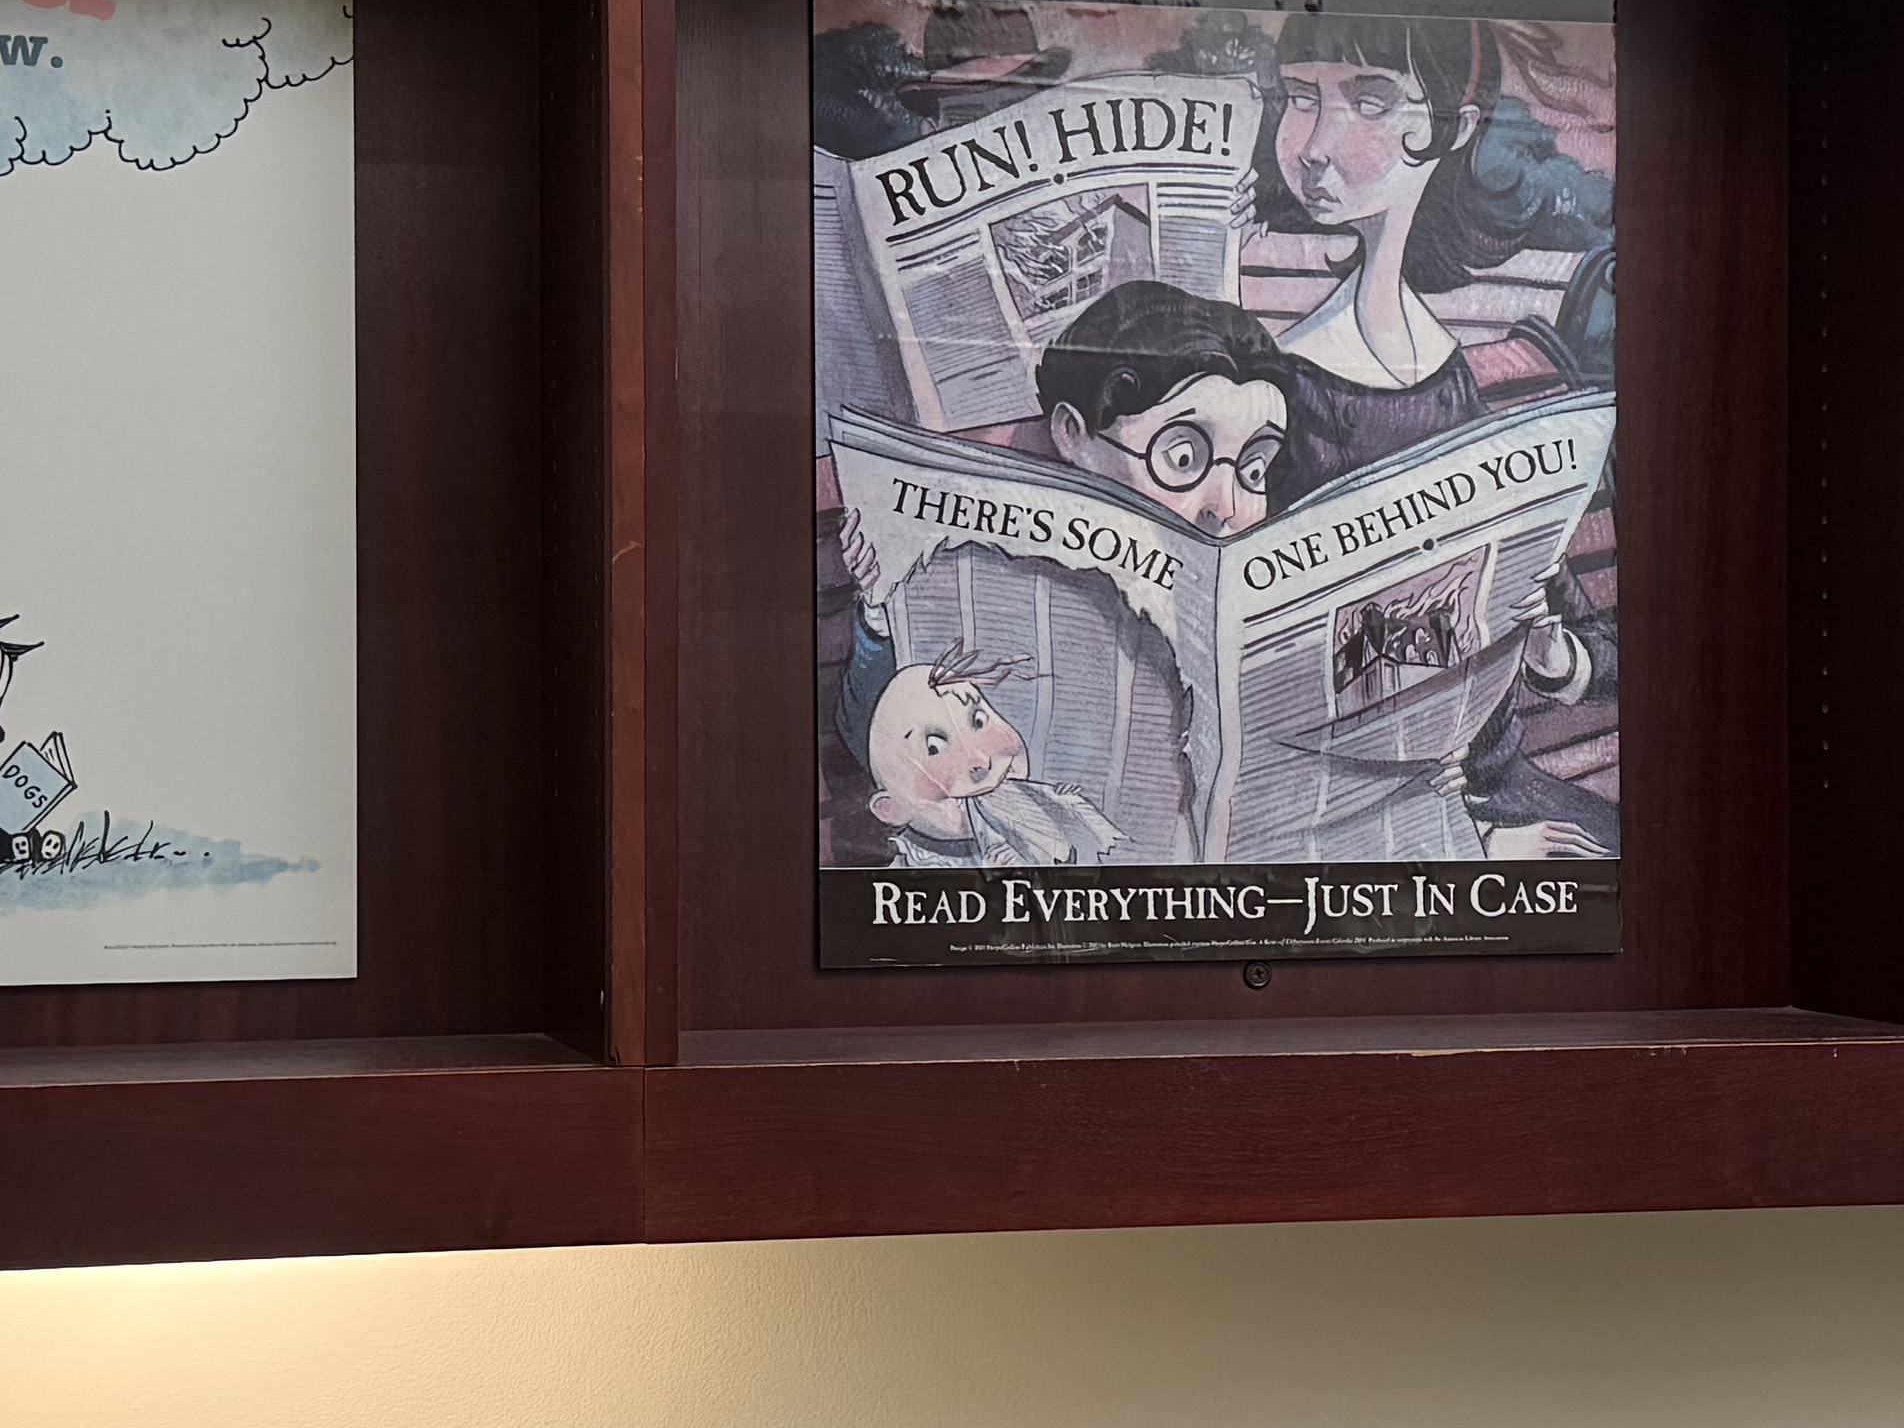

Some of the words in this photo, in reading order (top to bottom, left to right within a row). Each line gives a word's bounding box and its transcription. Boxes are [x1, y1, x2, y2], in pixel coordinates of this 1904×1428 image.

[876, 119, 1041, 227] RUN!
[1050, 97, 1233, 166] HIDE!
[892, 479, 1054, 547] THERE'S
[1061, 520, 1184, 591] SOME
[1242, 533, 1330, 593] ONE
[1337, 481, 1477, 560] BEHIND
[1486, 438, 1578, 492] YOU!
[0, 763, 50, 812] DOGS
[871, 880, 986, 925] READ
[1414, 876, 1455, 917] IN
[1468, 873, 1579, 916] CASE
